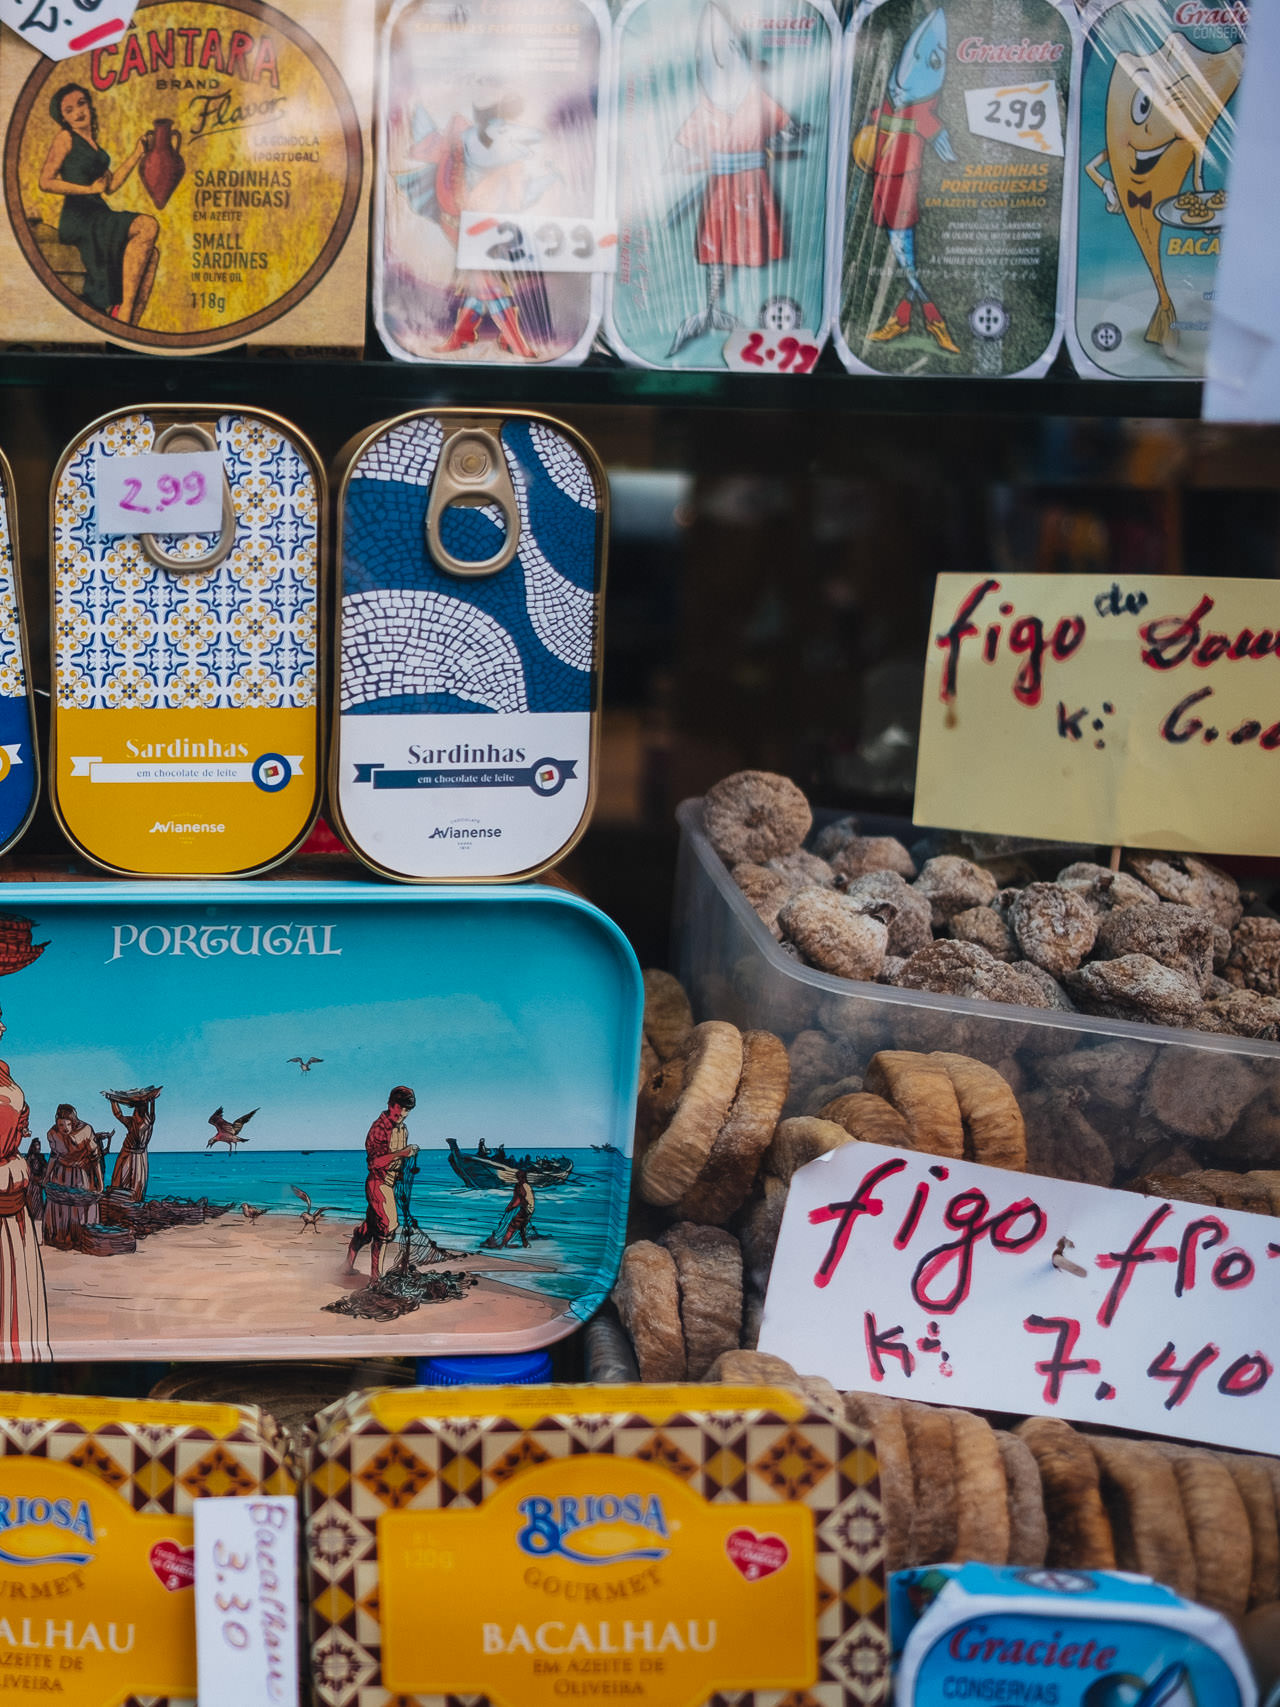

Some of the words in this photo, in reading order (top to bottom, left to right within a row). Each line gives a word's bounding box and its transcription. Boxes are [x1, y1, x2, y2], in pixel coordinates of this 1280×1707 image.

[957, 37, 1065, 65] Graciete
[156, 78, 220, 91] BRAND
[188, 89, 287, 135] Flavor
[984, 99, 1047, 131] 2.99
[195, 170, 292, 188] SARDINHAS
[964, 163, 1049, 177] SARDINHAS
[941, 179, 1048, 193] PORTUGUESAS
[195, 190, 290, 209] (PETINGAS)
[193, 233, 243, 250] SMALL
[486, 221, 596, 263] 2.99
[1167, 238, 1220, 255] BACA
[192, 252, 268, 270] SARDINES
[191, 292, 226, 313] 118g
[119, 471, 207, 514] 2.99
[935, 579, 1086, 708] figo
[126, 738, 249, 758] Sardinhas
[407, 744, 526, 765] Sardinhas
[154, 768, 199, 778] chocolate
[216, 768, 238, 777] leite
[434, 774, 478, 784] chocolate
[494, 773, 515, 782] leite
[149, 821, 226, 833] Avianense
[428, 826, 502, 839] Avianense
[103, 923, 342, 965] PORTUGAL
[808, 1157, 1048, 1315] figo
[1023, 1314, 1273, 1410] 7.40
[516, 1493, 671, 1556] BRIOSA
[212, 1539, 253, 1650] 3.30
[523, 1565, 664, 1604] GOURMET
[482, 1619, 716, 1655] BACALHAU
[948, 1625, 1117, 1671] Graciete
[62, 1655, 83, 1671] DE
[533, 1657, 561, 1674] EM
[566, 1656, 634, 1674] AZEITE
[640, 1656, 664, 1674] DE
[553, 1676, 644, 1696] OLIVEIRA
[942, 1676, 1060, 1705] CONSERVAS
